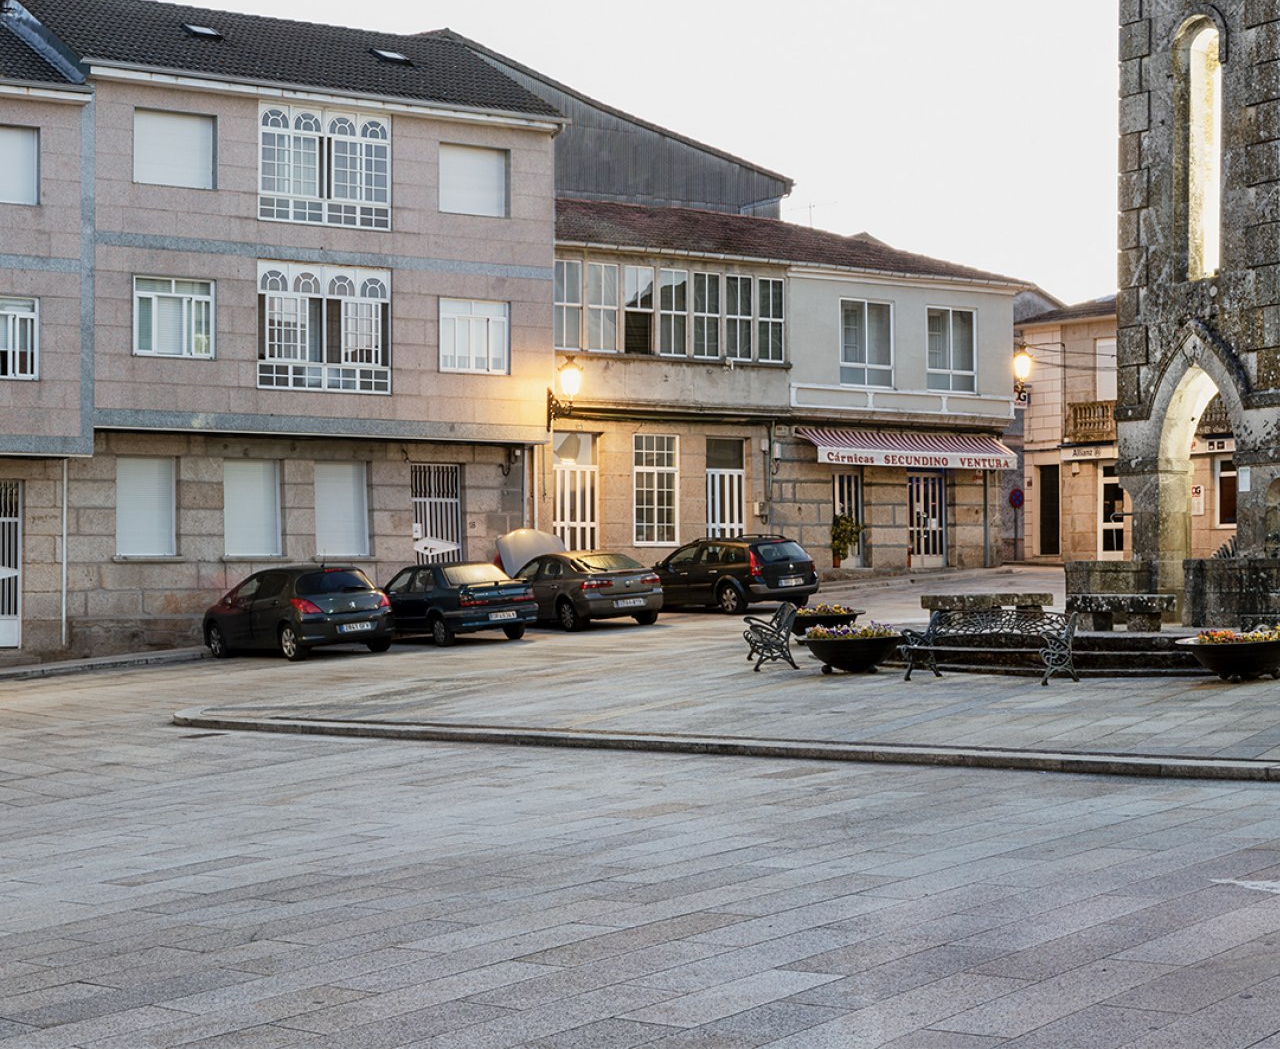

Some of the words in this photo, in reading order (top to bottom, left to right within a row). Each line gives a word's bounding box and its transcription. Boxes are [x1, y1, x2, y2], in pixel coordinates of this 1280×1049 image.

[1072, 449, 1093, 457] Allianz
[827, 451, 875, 464] Cárnicas
[884, 454, 949, 467] SECUNDINO
[960, 457, 1010, 468] VENTURA
